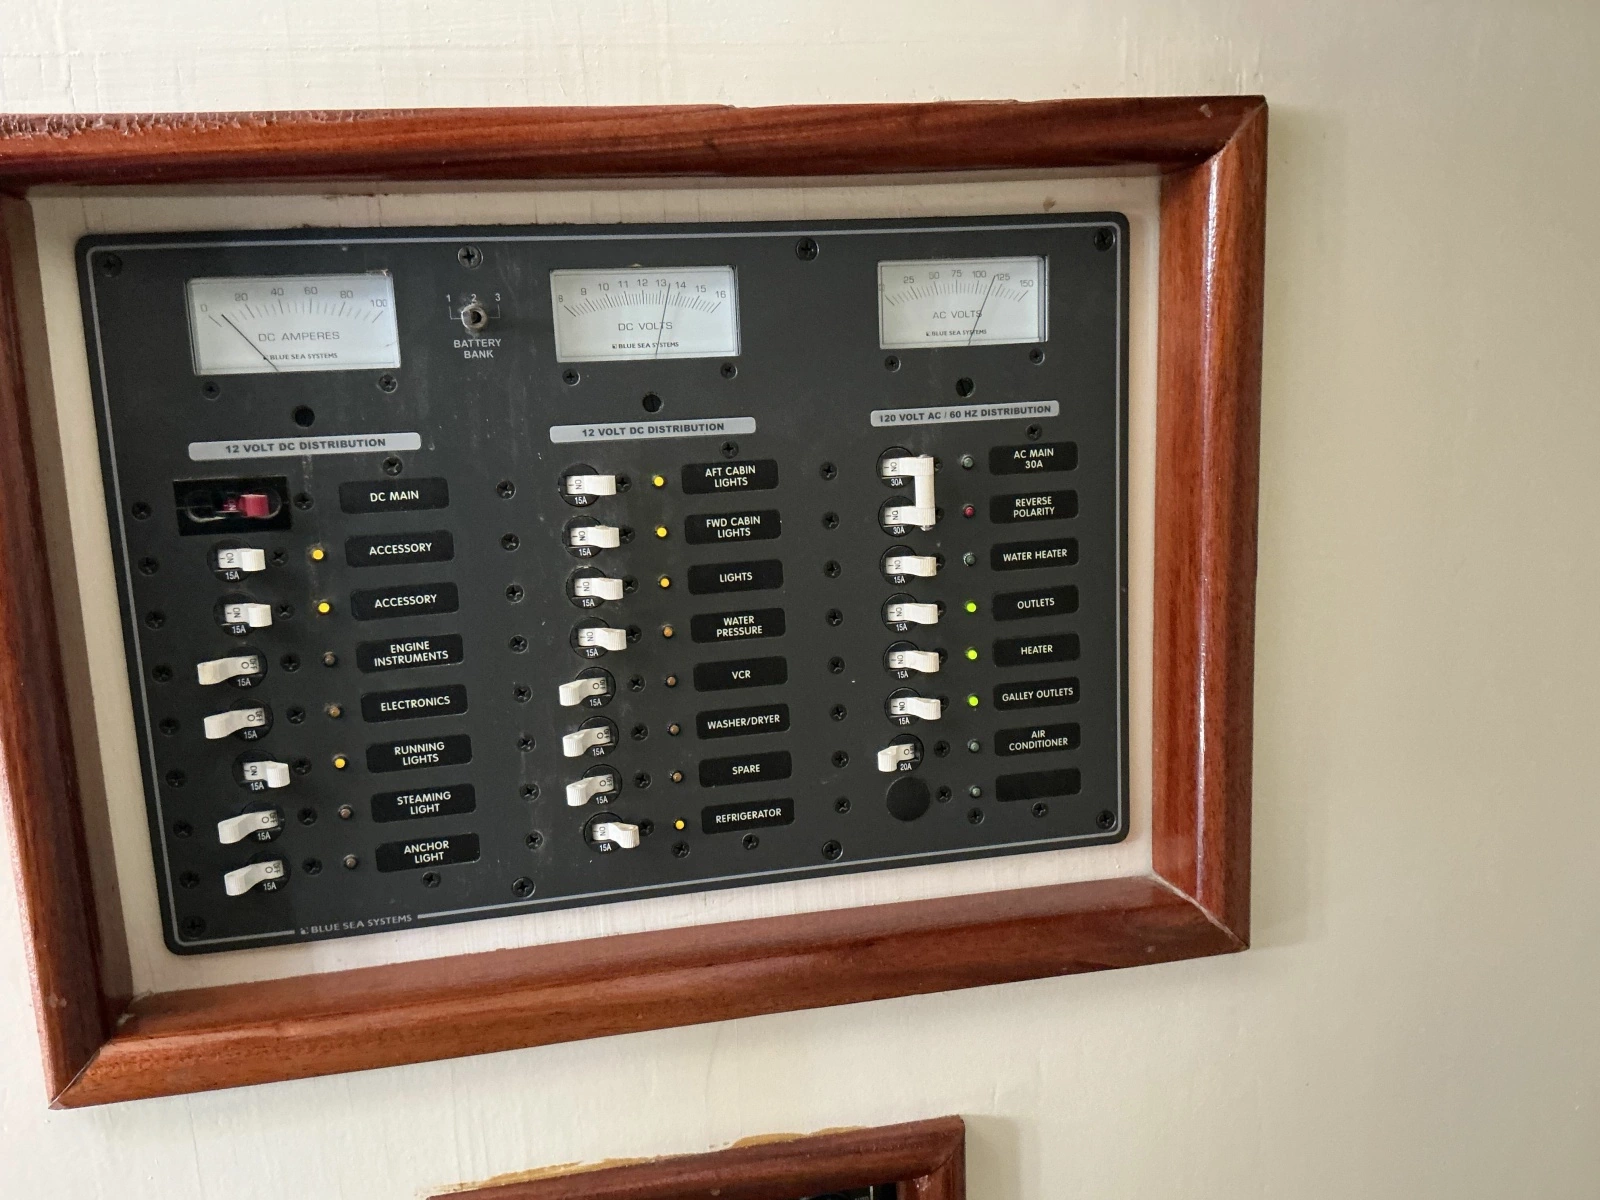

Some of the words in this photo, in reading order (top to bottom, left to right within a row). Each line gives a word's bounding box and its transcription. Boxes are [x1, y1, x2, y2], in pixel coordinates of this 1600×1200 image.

[235, 293, 248, 301] 20
[200, 304, 207, 312] 0
[259, 333, 275, 341] DC
[282, 331, 340, 341] AMPERES
[454, 339, 501, 348] BATTERY
[464, 350, 493, 359] BANK
[981, 406, 1051, 416] DISTRIBUTION
[648, 423, 724, 433] DISTRIBUTION
[226, 445, 238, 453] 12
[243, 444, 274, 452] VOLT
[279, 442, 295, 451] DC
[300, 438, 386, 450] DISTRIBUTION
[1014, 451, 1026, 459] AC
[1029, 448, 1054, 458] MAIN
[890, 462, 897, 472] ON
[1025, 460, 1043, 469] 30A
[706, 468, 722, 477] AFT
[726, 465, 756, 475] CABIN
[575, 480, 581, 490] ON
[715, 477, 748, 488] LIGHTS
[370, 492, 386, 502] DC
[390, 490, 419, 500] MAIN
[1016, 497, 1052, 507] REVERSE
[892, 511, 898, 520] ON
[1013, 507, 1055, 518] POLARITY
[706, 518, 727, 528] FWD
[731, 516, 760, 526] CABIN
[579, 531, 585, 541] ON
[718, 528, 751, 538] LIGHTS
[369, 543, 432, 555] ACCESSORY
[1003, 552, 1032, 562] WATER
[1035, 549, 1067, 559] HEATER
[894, 560, 900, 570] ON
[225, 572, 239, 580] 15A
[720, 572, 752, 583] LIGHTS
[583, 582, 590, 591] ON
[374, 594, 437, 608] ACCESSORY
[1017, 598, 1055, 609] OUTLETS
[724, 616, 754, 626] WATER
[232, 625, 246, 634] 15A
[717, 626, 762, 637] PRESSURE
[587, 632, 593, 641] ON
[390, 641, 430, 653] ENGINE
[1021, 645, 1053, 655] HEATER
[374, 651, 448, 667] INSTRUMENTS
[898, 655, 903, 664] ON
[732, 670, 751, 680] VCR
[238, 678, 251, 686] 15A
[1002, 691, 1033, 701] GALLEY
[1037, 688, 1073, 698] OUTLETS
[381, 696, 450, 712] ELECTRONICS
[590, 699, 602, 707] 15A
[899, 702, 905, 711] ON
[707, 715, 780, 729] WASHER/DRYER
[244, 730, 258, 739] 15A
[1032, 730, 1045, 738] AIR
[394, 742, 444, 755] RUNNING
[1009, 738, 1068, 751] CONDITIONER
[593, 748, 604, 756] 15A
[402, 754, 439, 766] LIGHTS
[732, 764, 760, 775] SPARE
[901, 762, 912, 771] 20A
[250, 782, 264, 790] 15A
[397, 792, 451, 806] STEAMING
[596, 796, 608, 804] 15A
[410, 804, 440, 815] LIGHT
[716, 808, 781, 823] REFRIGERATOR
[258, 832, 271, 840] 15A
[599, 827, 606, 836] ON
[404, 841, 449, 854] ANCHOR
[599, 843, 611, 851] 15A
[414, 852, 444, 864] LIGHT
[264, 882, 276, 890] 15A
[311, 922, 340, 934] BLUE
[343, 920, 364, 930] SEA
[368, 914, 412, 927] SYSTEMS
